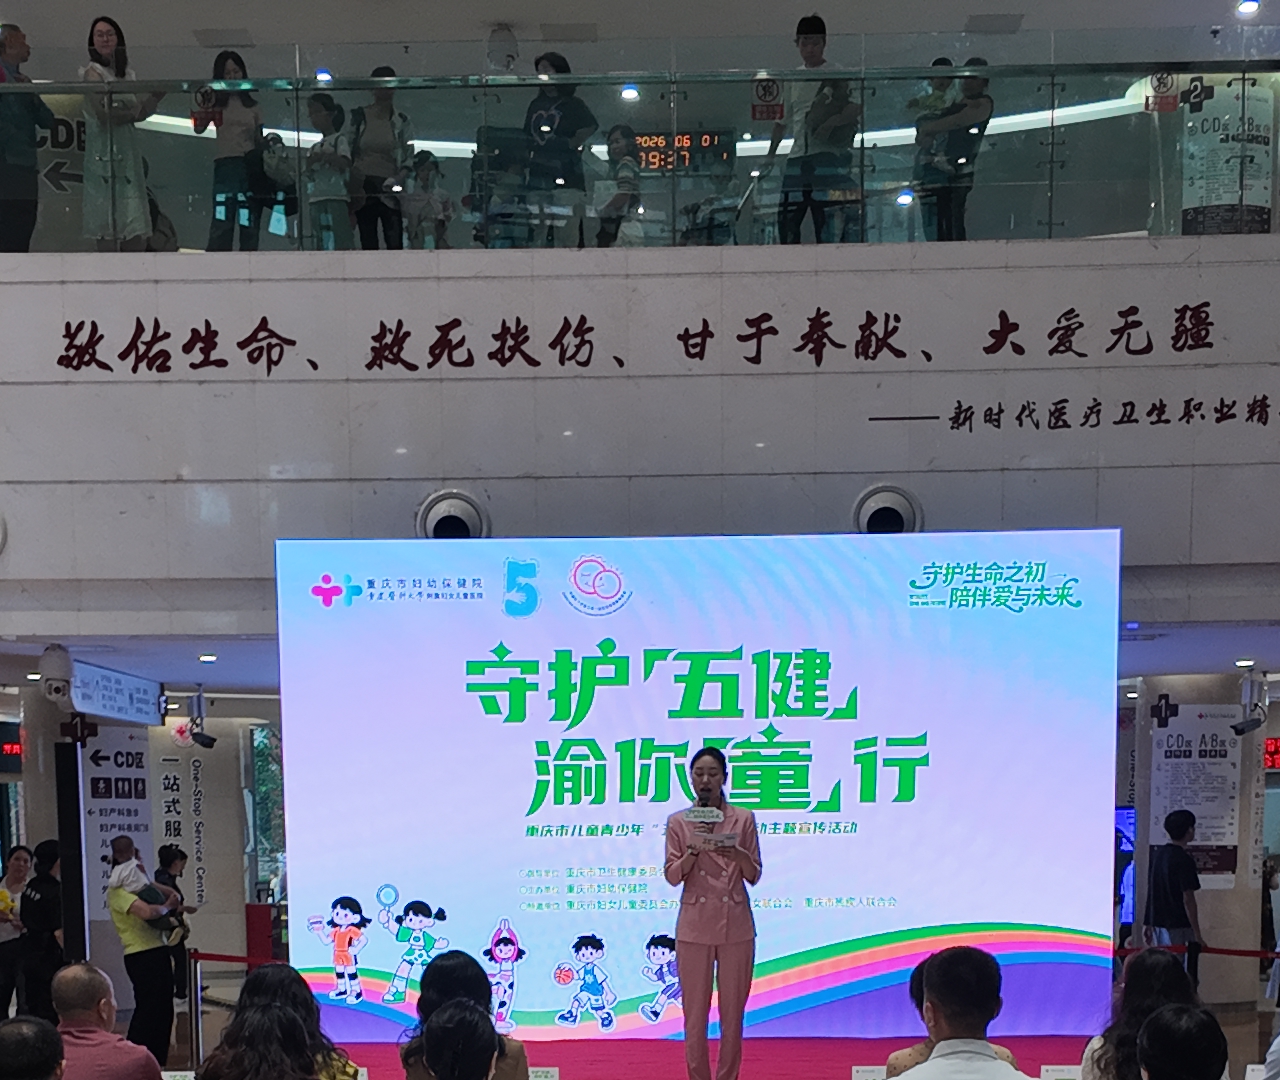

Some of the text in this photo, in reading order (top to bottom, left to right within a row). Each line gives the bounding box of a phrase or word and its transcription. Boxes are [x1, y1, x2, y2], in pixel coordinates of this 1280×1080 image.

[909, 561, 1048, 590] 守护生命之初
[948, 578, 1083, 614] 陪伴爱与未来
[113, 750, 145, 769] CD区
[162, 756, 183, 850] 一站式服
